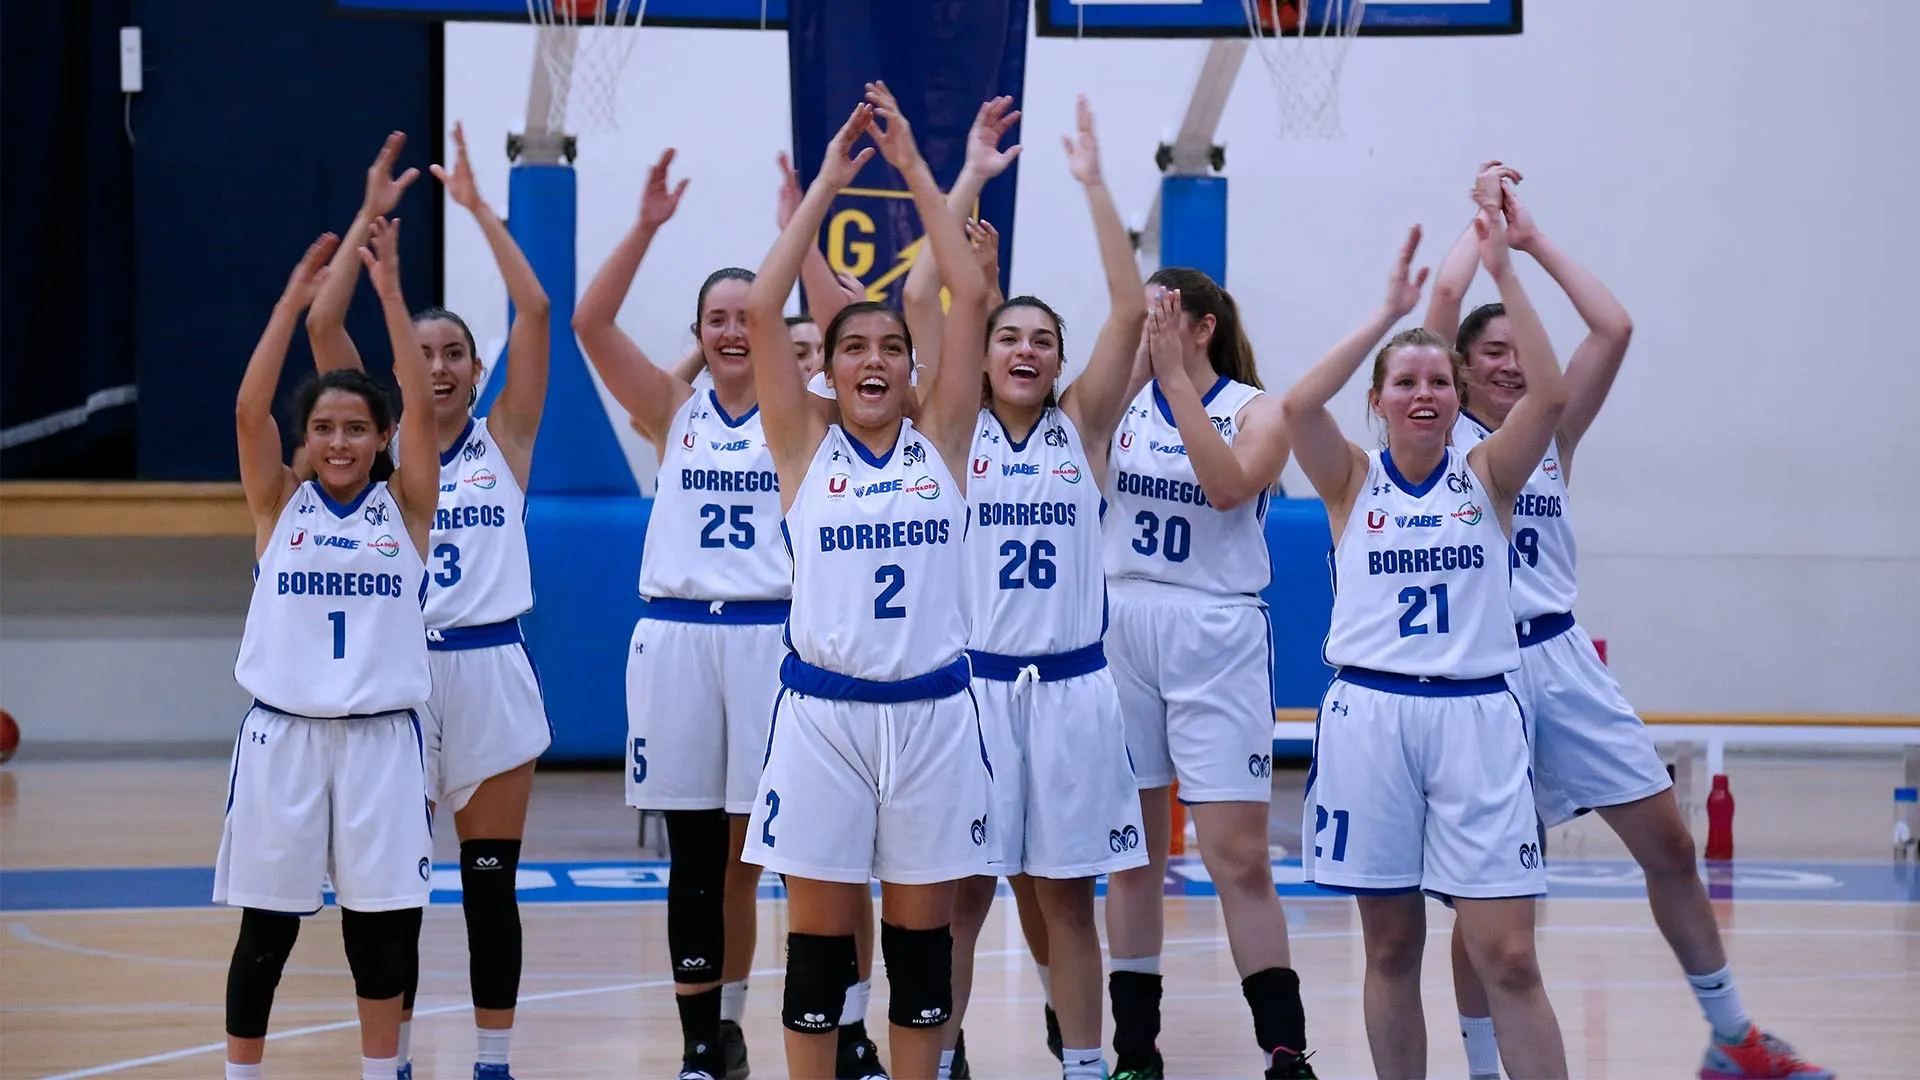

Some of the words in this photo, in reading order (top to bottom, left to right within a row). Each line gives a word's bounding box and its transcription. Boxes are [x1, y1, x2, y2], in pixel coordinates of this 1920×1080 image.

[828, 209, 876, 278] G
[864, 479, 904, 497] ABE
[1117, 470, 1213, 508] BORREGO
[431, 504, 505, 530] REGOS
[699, 503, 756, 550] 25
[819, 518, 950, 553] BORREGOS
[978, 501, 1076, 528] BORREGOS
[1406, 515, 1443, 528] ABE
[323, 536, 362, 550] ABE
[1131, 509, 1192, 563] 30
[433, 542, 462, 588] 3
[998, 539, 1057, 590] 26
[1368, 544, 1485, 576] BORREGOS
[277, 571, 403, 599] BORREGOS
[873, 563, 907, 620] 2
[1397, 582, 1450, 638] 21
[327, 610, 346, 660] 1
[762, 788, 781, 848] 2
